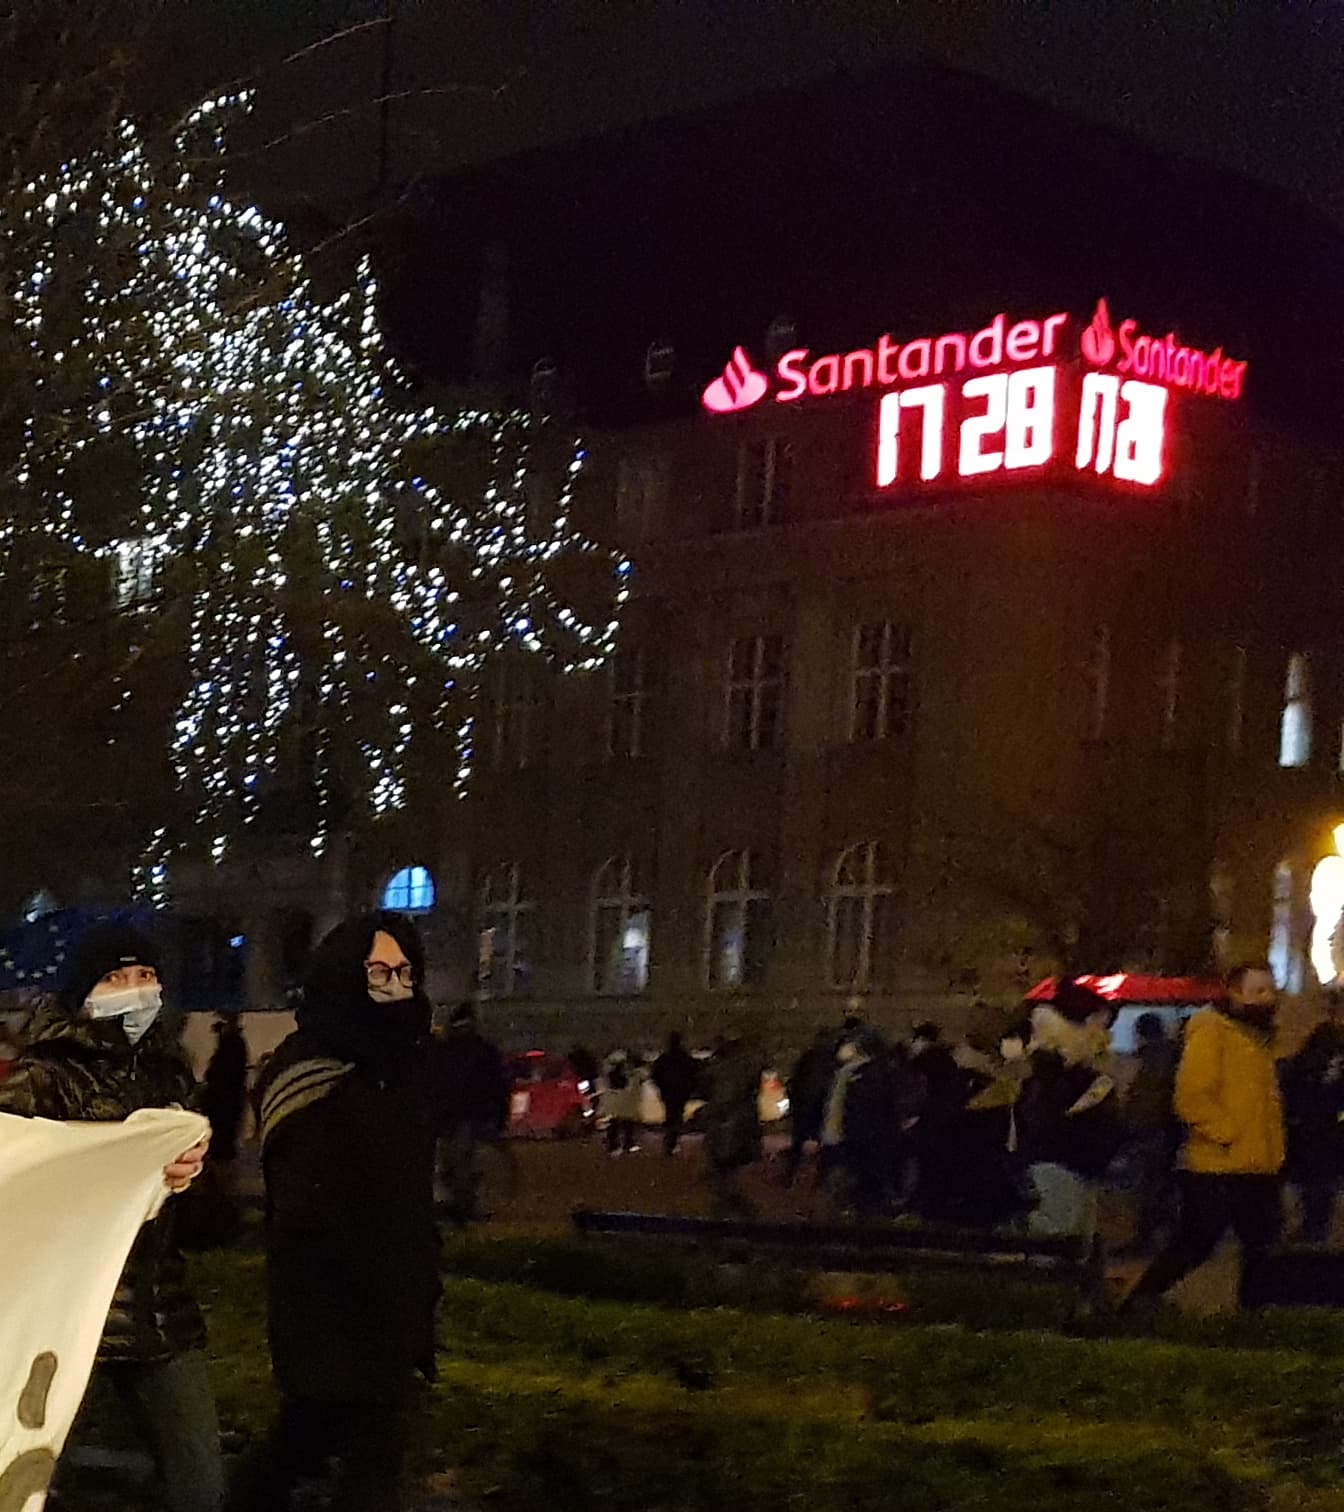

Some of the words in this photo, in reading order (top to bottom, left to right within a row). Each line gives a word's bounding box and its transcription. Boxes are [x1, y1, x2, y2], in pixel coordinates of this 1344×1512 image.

[776, 313, 1068, 402] Santander
[1117, 320, 1247, 399] Santander
[958, 366, 1056, 476] 28
